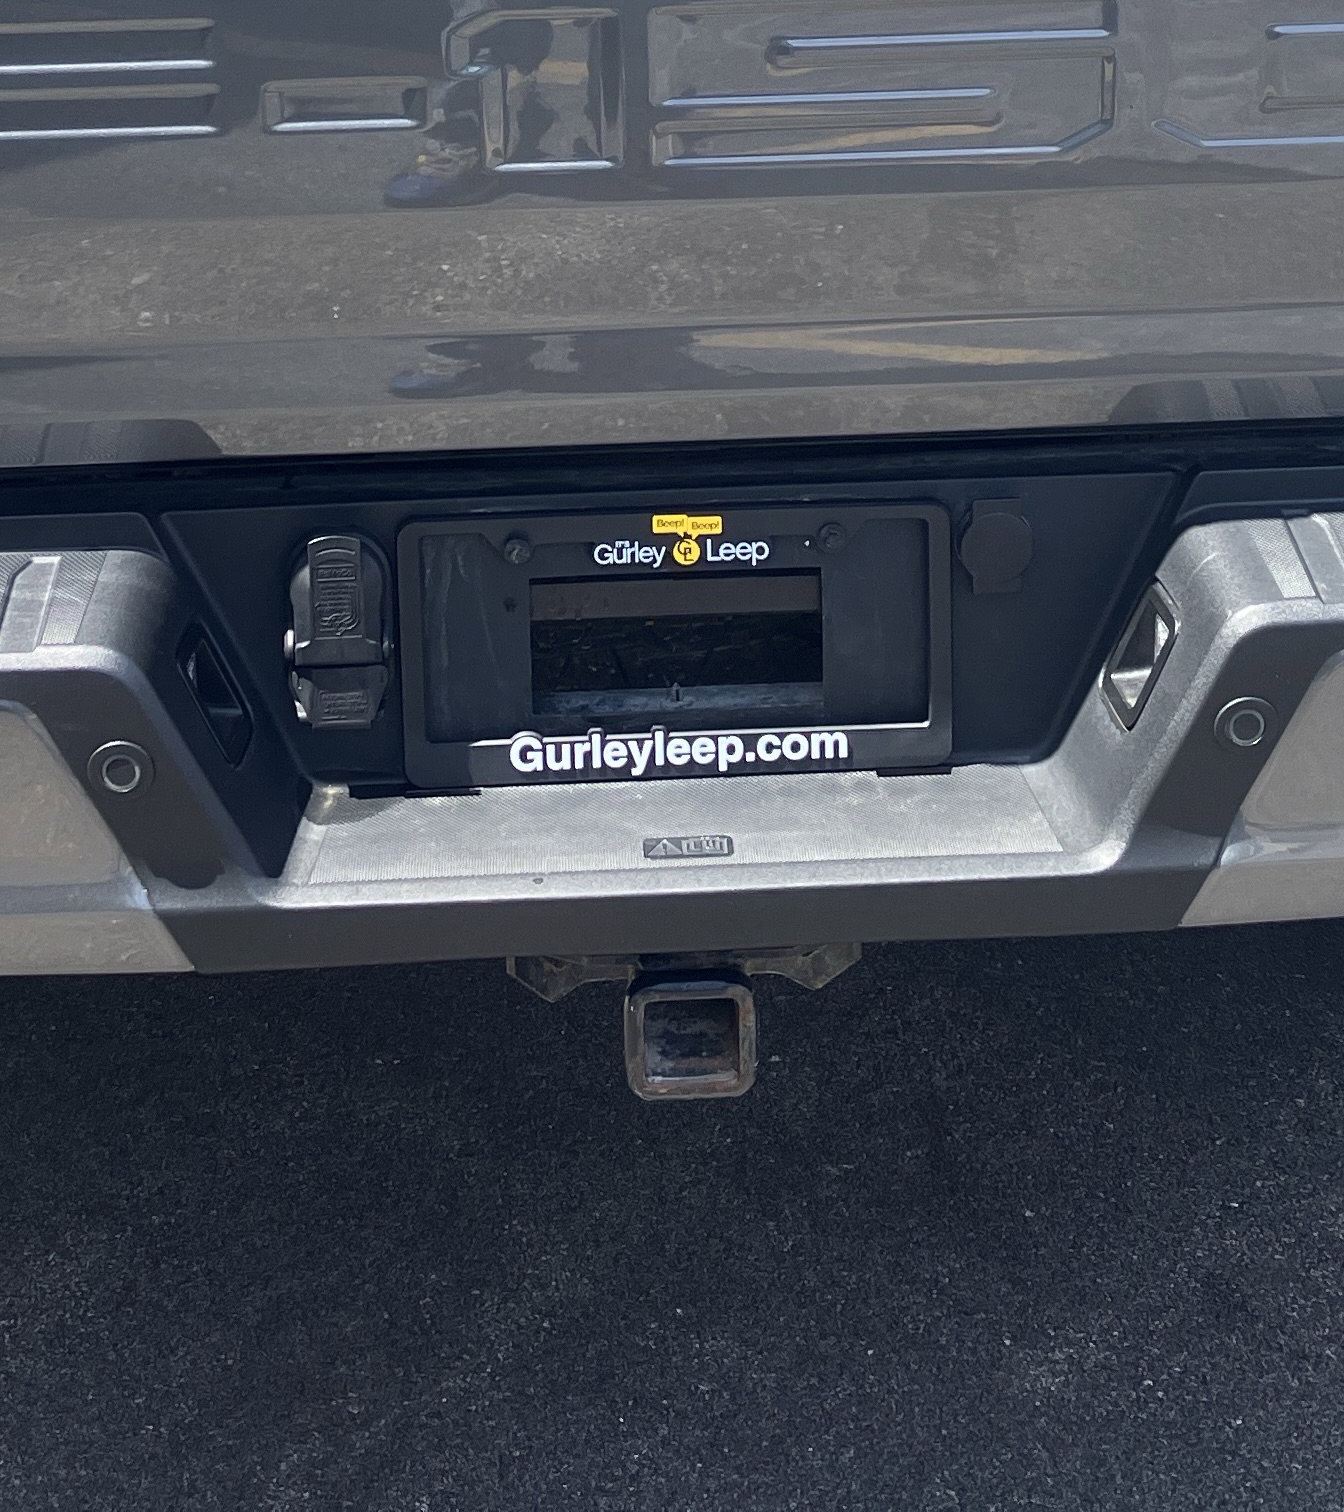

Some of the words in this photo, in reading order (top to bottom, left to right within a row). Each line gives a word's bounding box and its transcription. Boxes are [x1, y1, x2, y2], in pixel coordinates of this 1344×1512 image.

[656, 518, 685, 528] Beep!
[691, 520, 719, 531] Beep!
[706, 538, 770, 567] Leep
[509, 730, 849, 776] Gurleyleep.com
